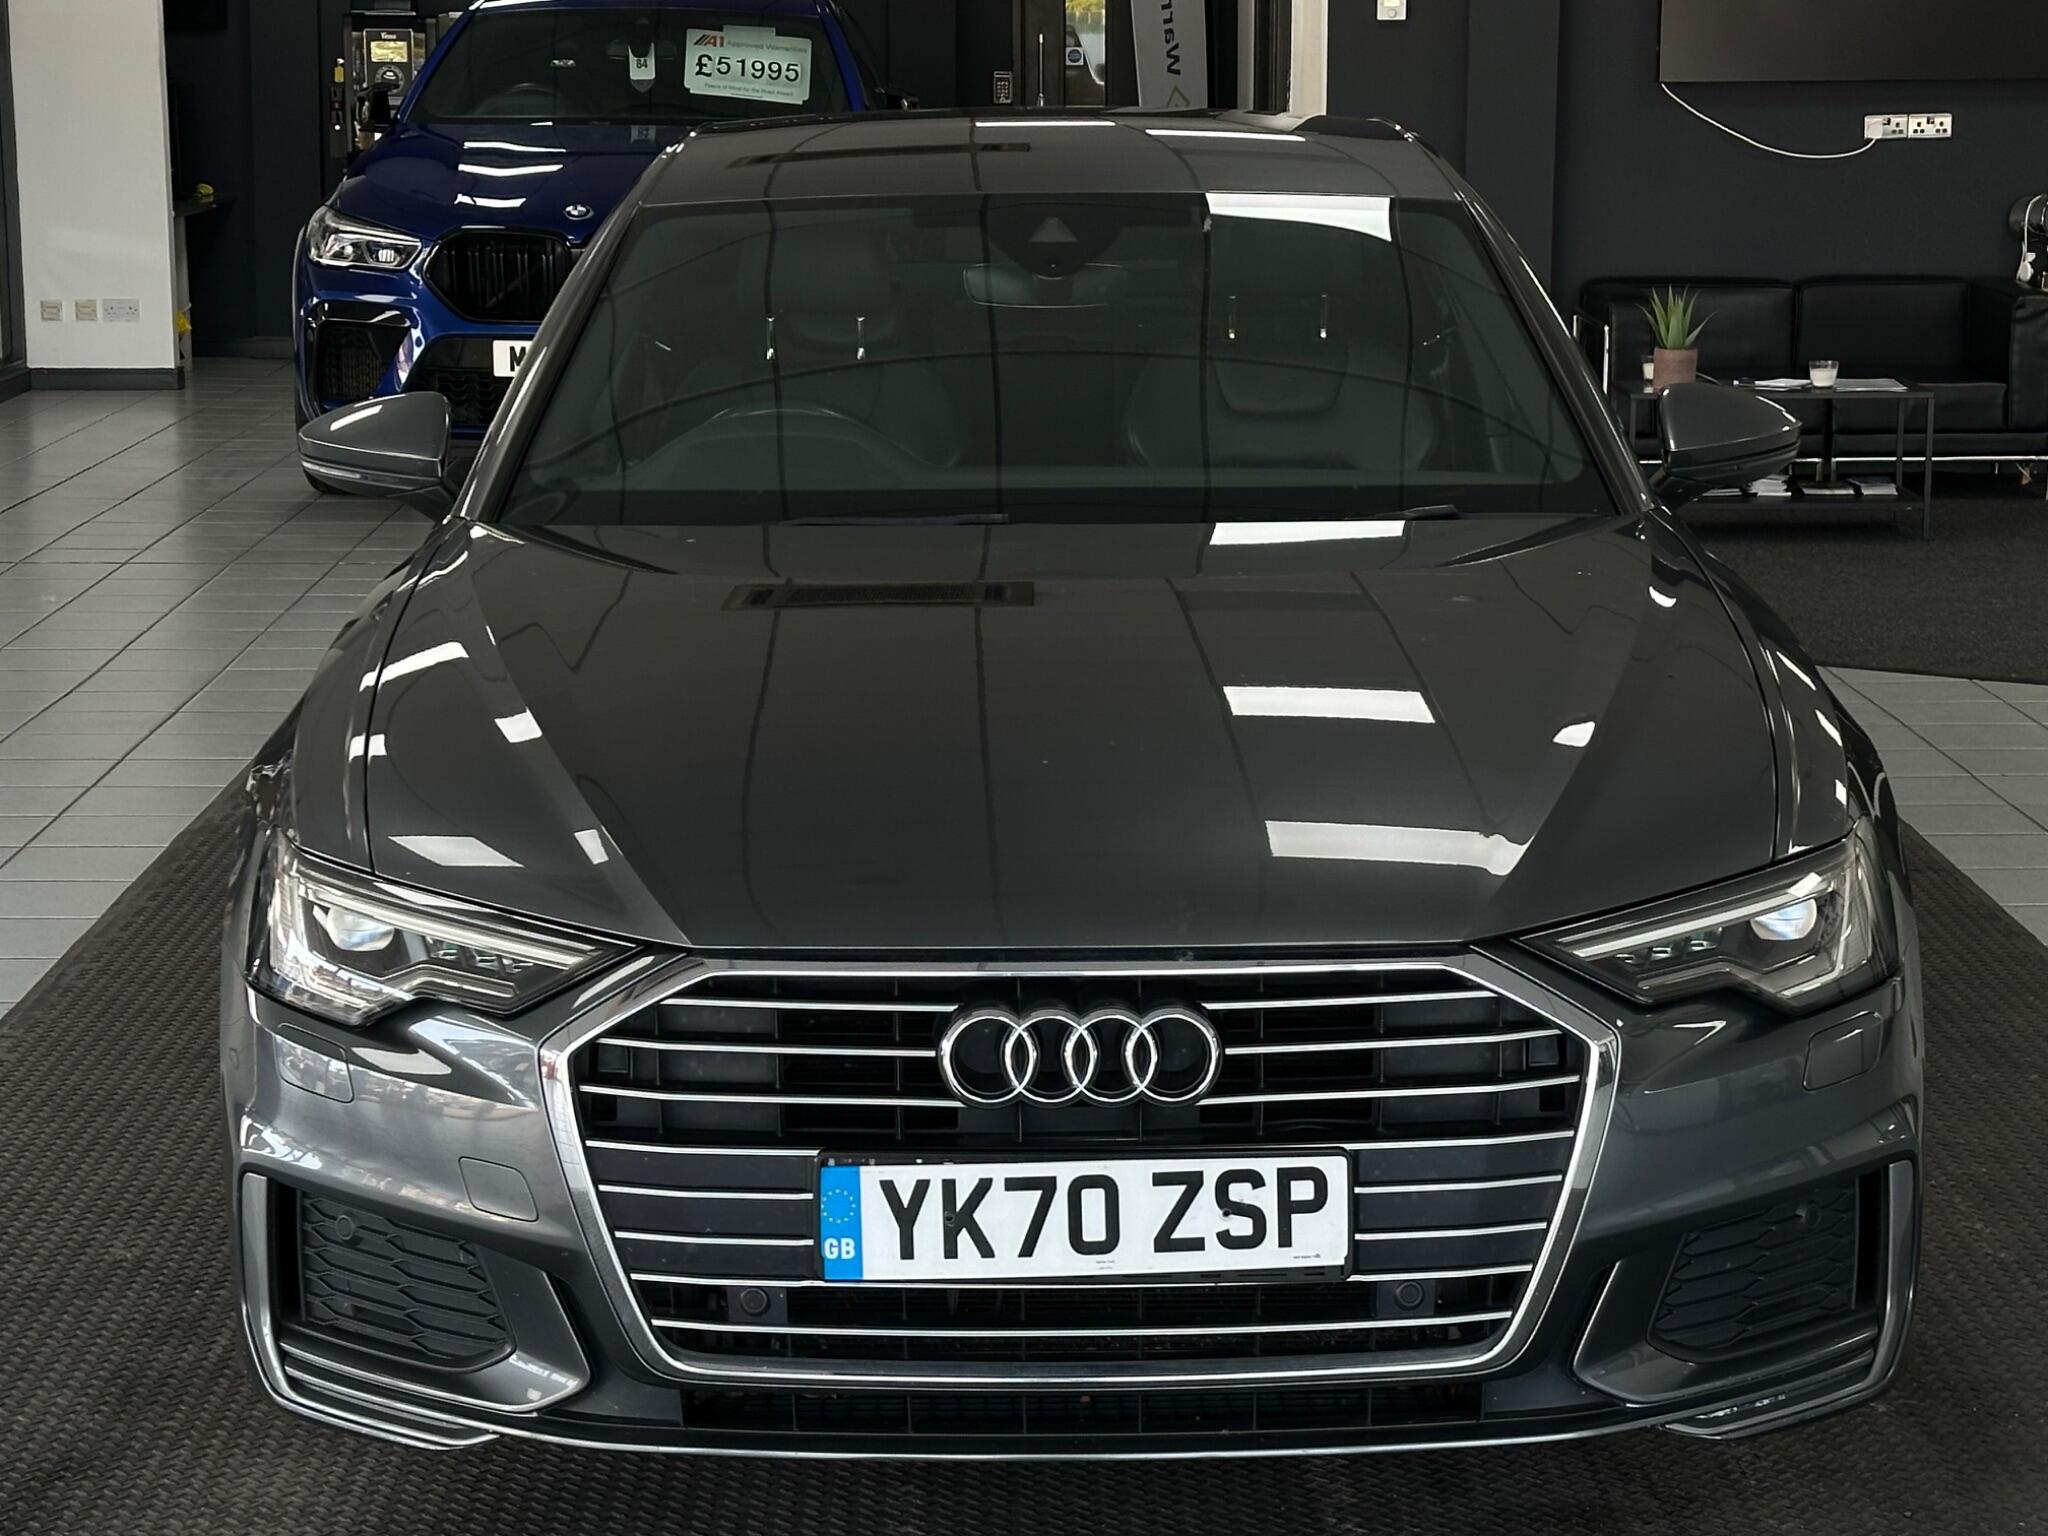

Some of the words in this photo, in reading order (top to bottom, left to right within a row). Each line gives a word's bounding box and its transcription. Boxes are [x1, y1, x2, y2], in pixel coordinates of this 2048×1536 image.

[695, 53, 799, 82] £51995
[879, 1174, 1120, 1260] YK70
[1152, 1166, 1328, 1253] ZSP
[823, 1236, 856, 1260] GB
